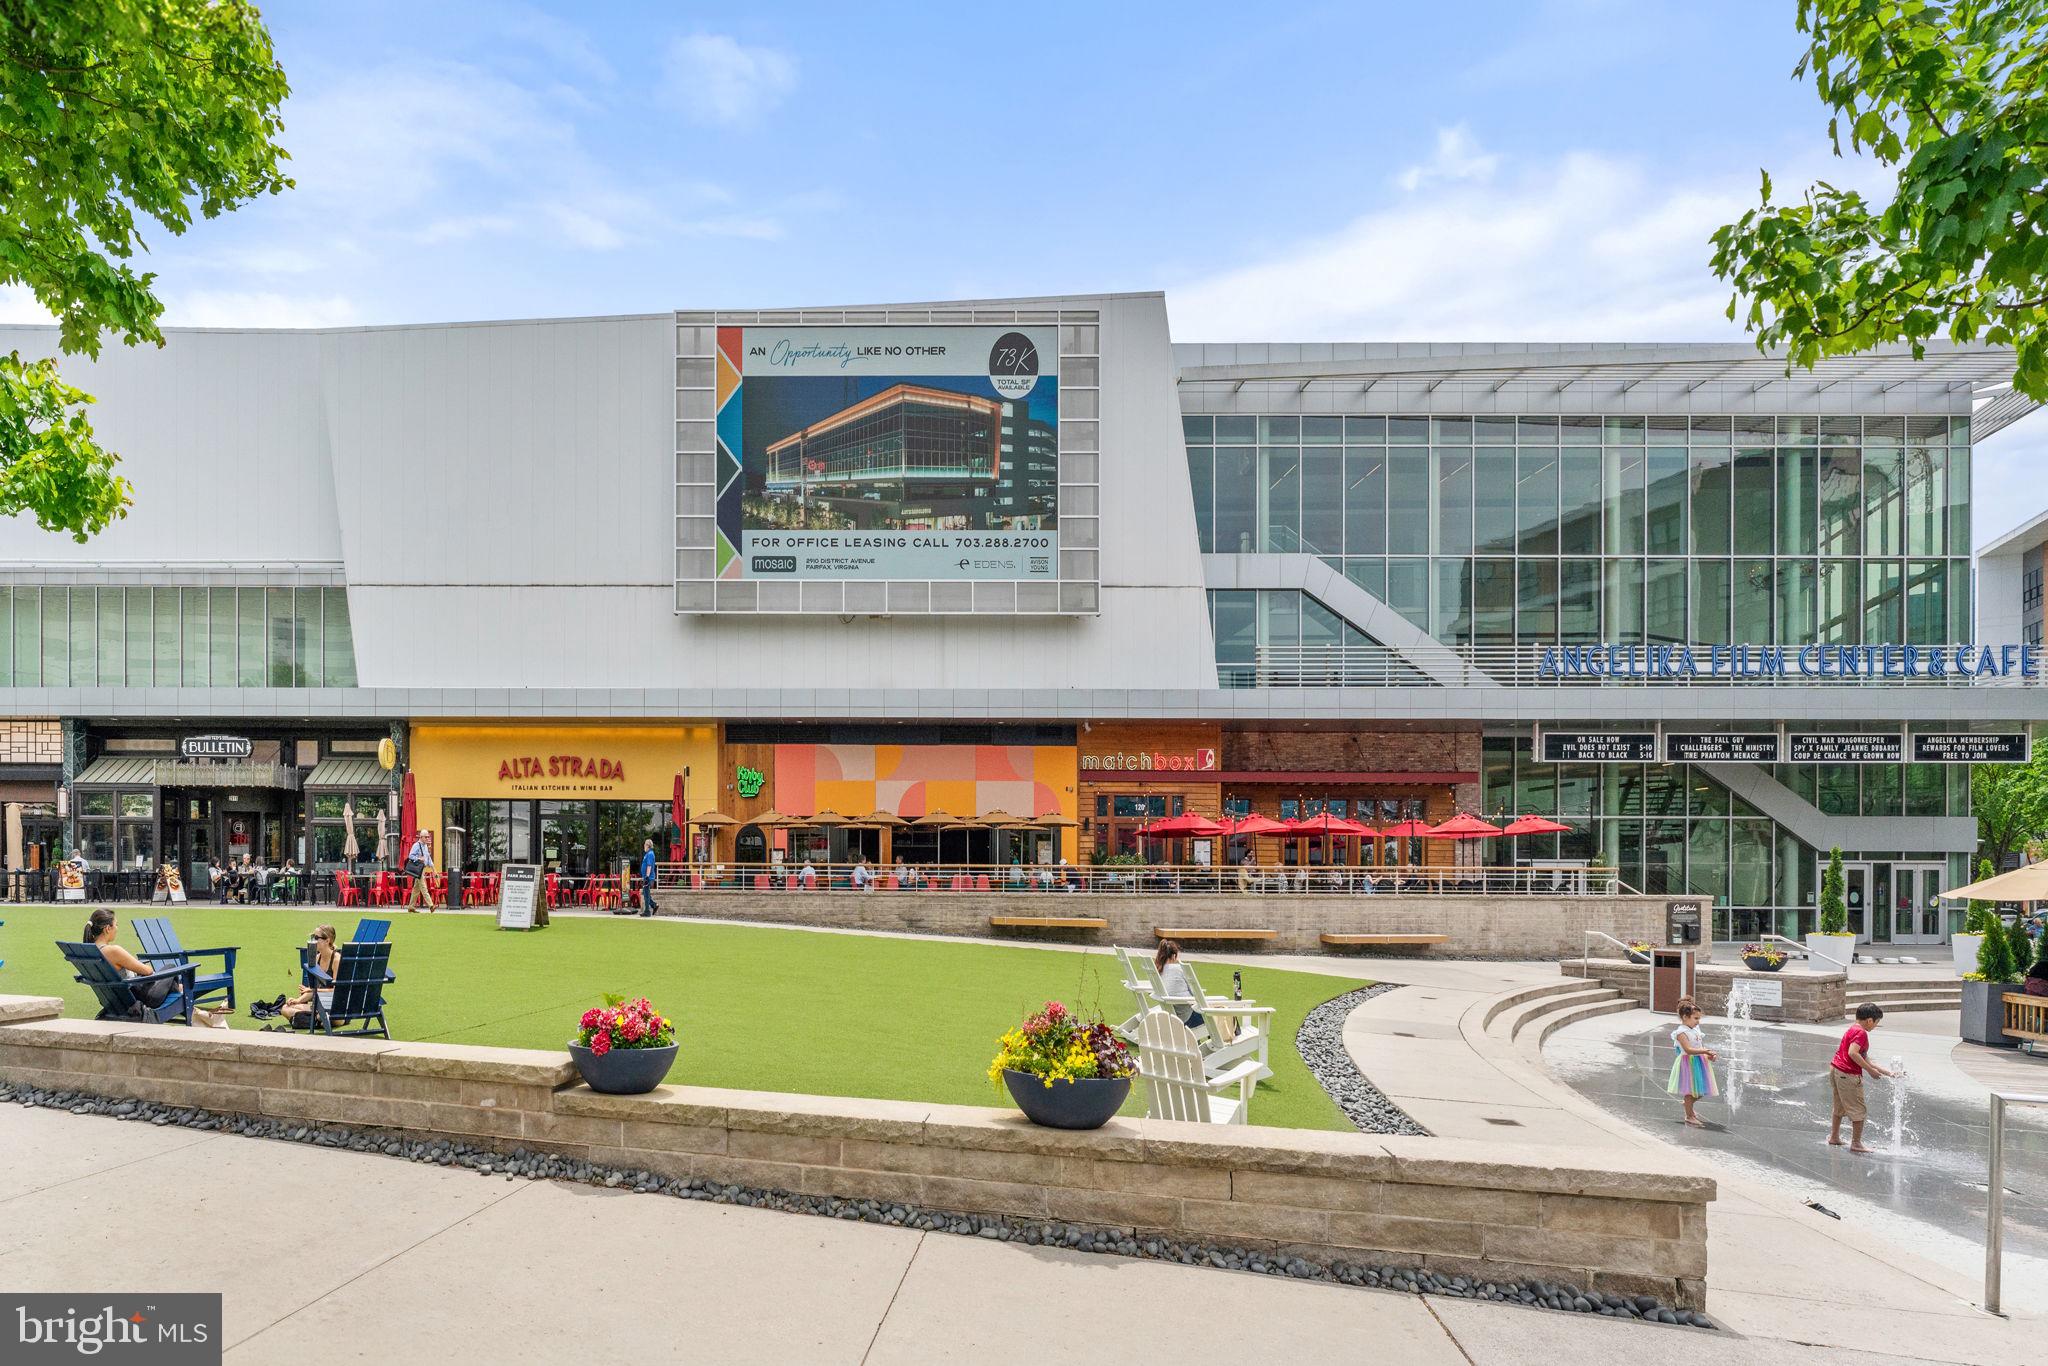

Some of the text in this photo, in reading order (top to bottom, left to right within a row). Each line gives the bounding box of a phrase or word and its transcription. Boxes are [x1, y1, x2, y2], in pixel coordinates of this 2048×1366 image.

[750, 339, 946, 368] AN Opportunity LIKE NO OTHER
[997, 348, 1036, 375] 73K
[752, 538, 1049, 548] FOR OFFICE LEASING CALL 703.288.2700
[754, 559, 794, 570] mosaic
[1539, 644, 2040, 677] ANGELIKA FILM CENTER & CAFE
[188, 742, 244, 753] BULLETIN
[498, 756, 624, 782] ALTA STRADA
[1082, 752, 1194, 770] matchbox
[736, 766, 765, 786] Kirby
[738, 780, 760, 794] Club
